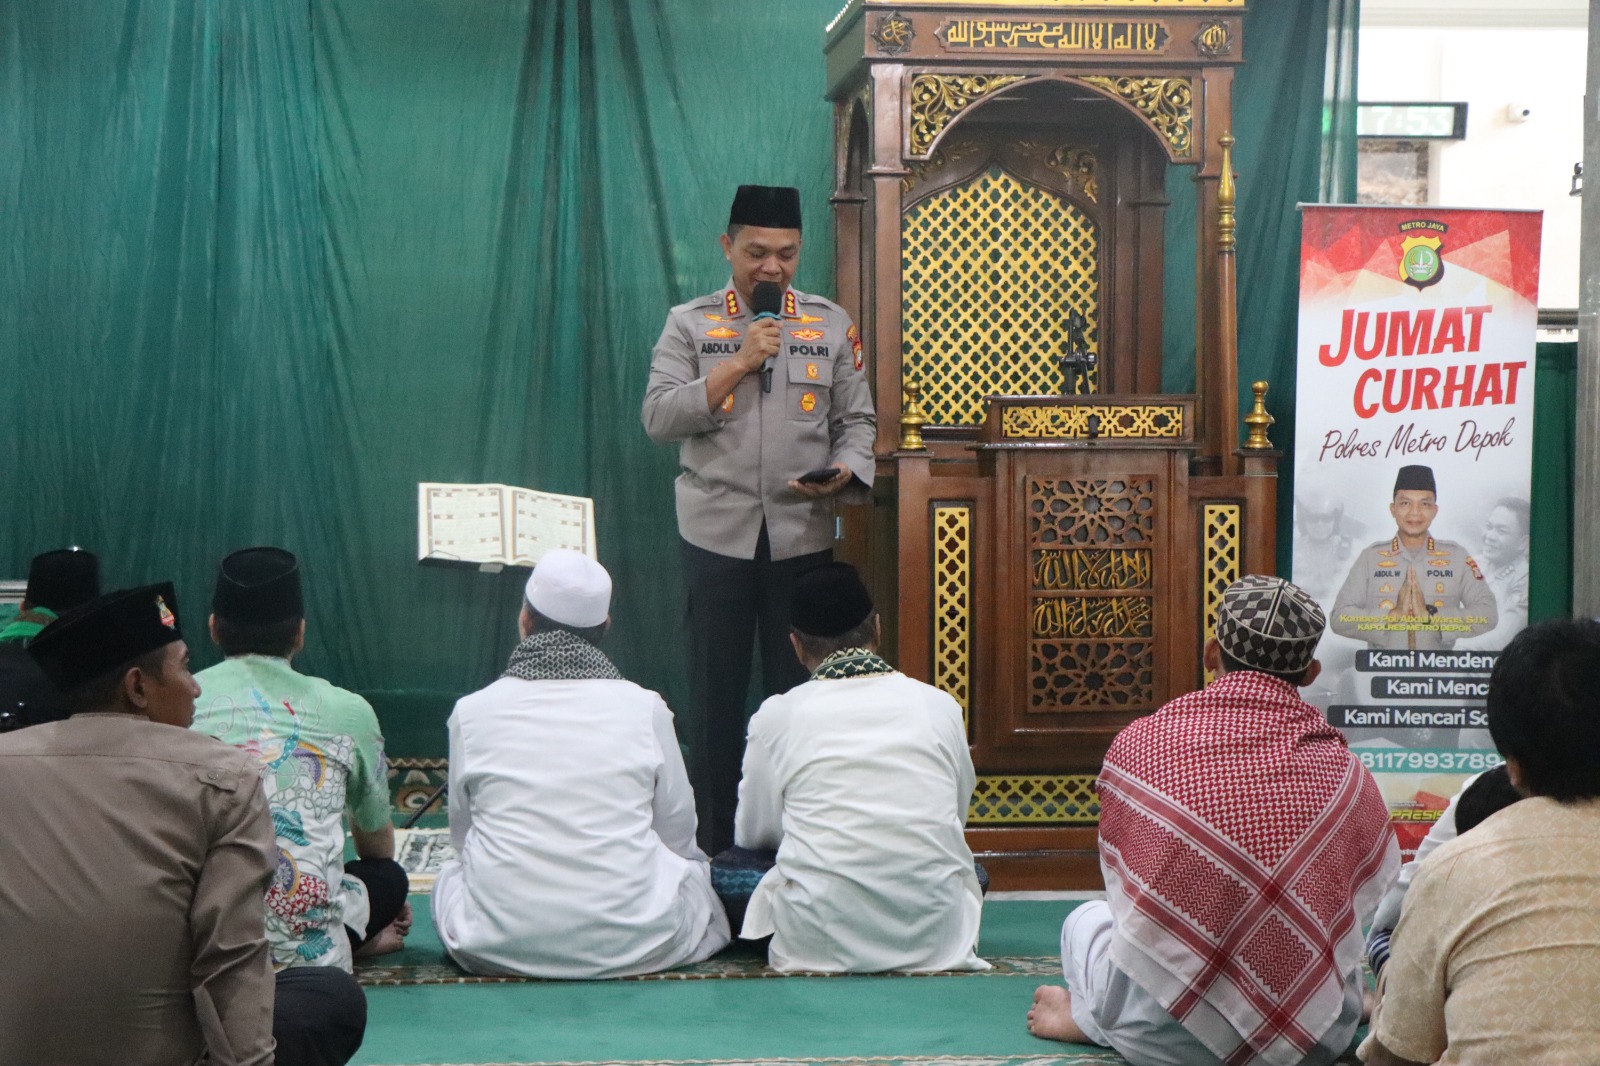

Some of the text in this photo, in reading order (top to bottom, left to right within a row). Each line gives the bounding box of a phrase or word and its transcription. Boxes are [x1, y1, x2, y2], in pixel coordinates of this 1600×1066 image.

[1401, 221, 1445, 232] METRO JAYA
[1318, 304, 1493, 367] JUMAT
[789, 345, 829, 358] POLRI
[1353, 361, 1527, 419] CURHAT
[1319, 416, 1516, 462] Polres Metro Depok
[1427, 569, 1453, 577] POLRI
[1358, 623, 1473, 633] KAPOLRES METRO DEPOK
[1369, 651, 1415, 667] Kami
[1387, 678, 1490, 695] Kami Menc
[1344, 708, 1390, 724] Kami
[1394, 709, 1466, 725] Mencari
